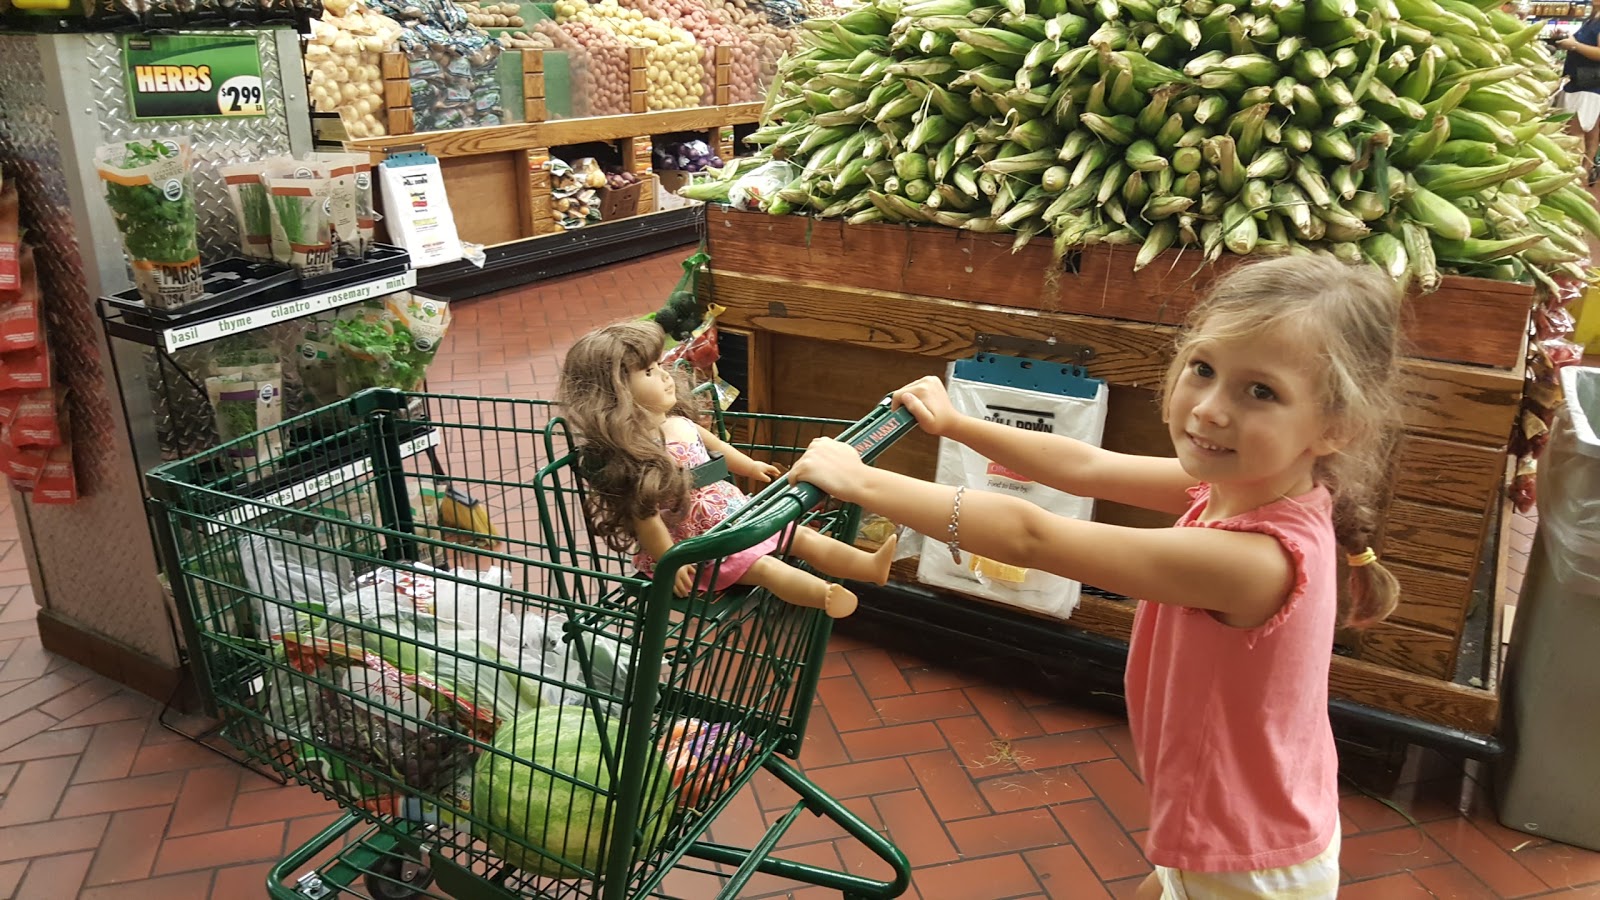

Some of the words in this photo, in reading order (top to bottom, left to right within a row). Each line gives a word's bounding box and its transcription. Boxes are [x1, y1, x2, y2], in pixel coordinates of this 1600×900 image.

[134, 65, 212, 92] HERBS
[171, 327, 198, 344] basil
[218, 316, 252, 332] thyme
[271, 301, 311, 318] cilantro
[328, 285, 371, 305] rosemary
[386, 276, 406, 290] mint
[869, 417, 901, 443] MARKET
[1016, 420, 1054, 434] DOWN
